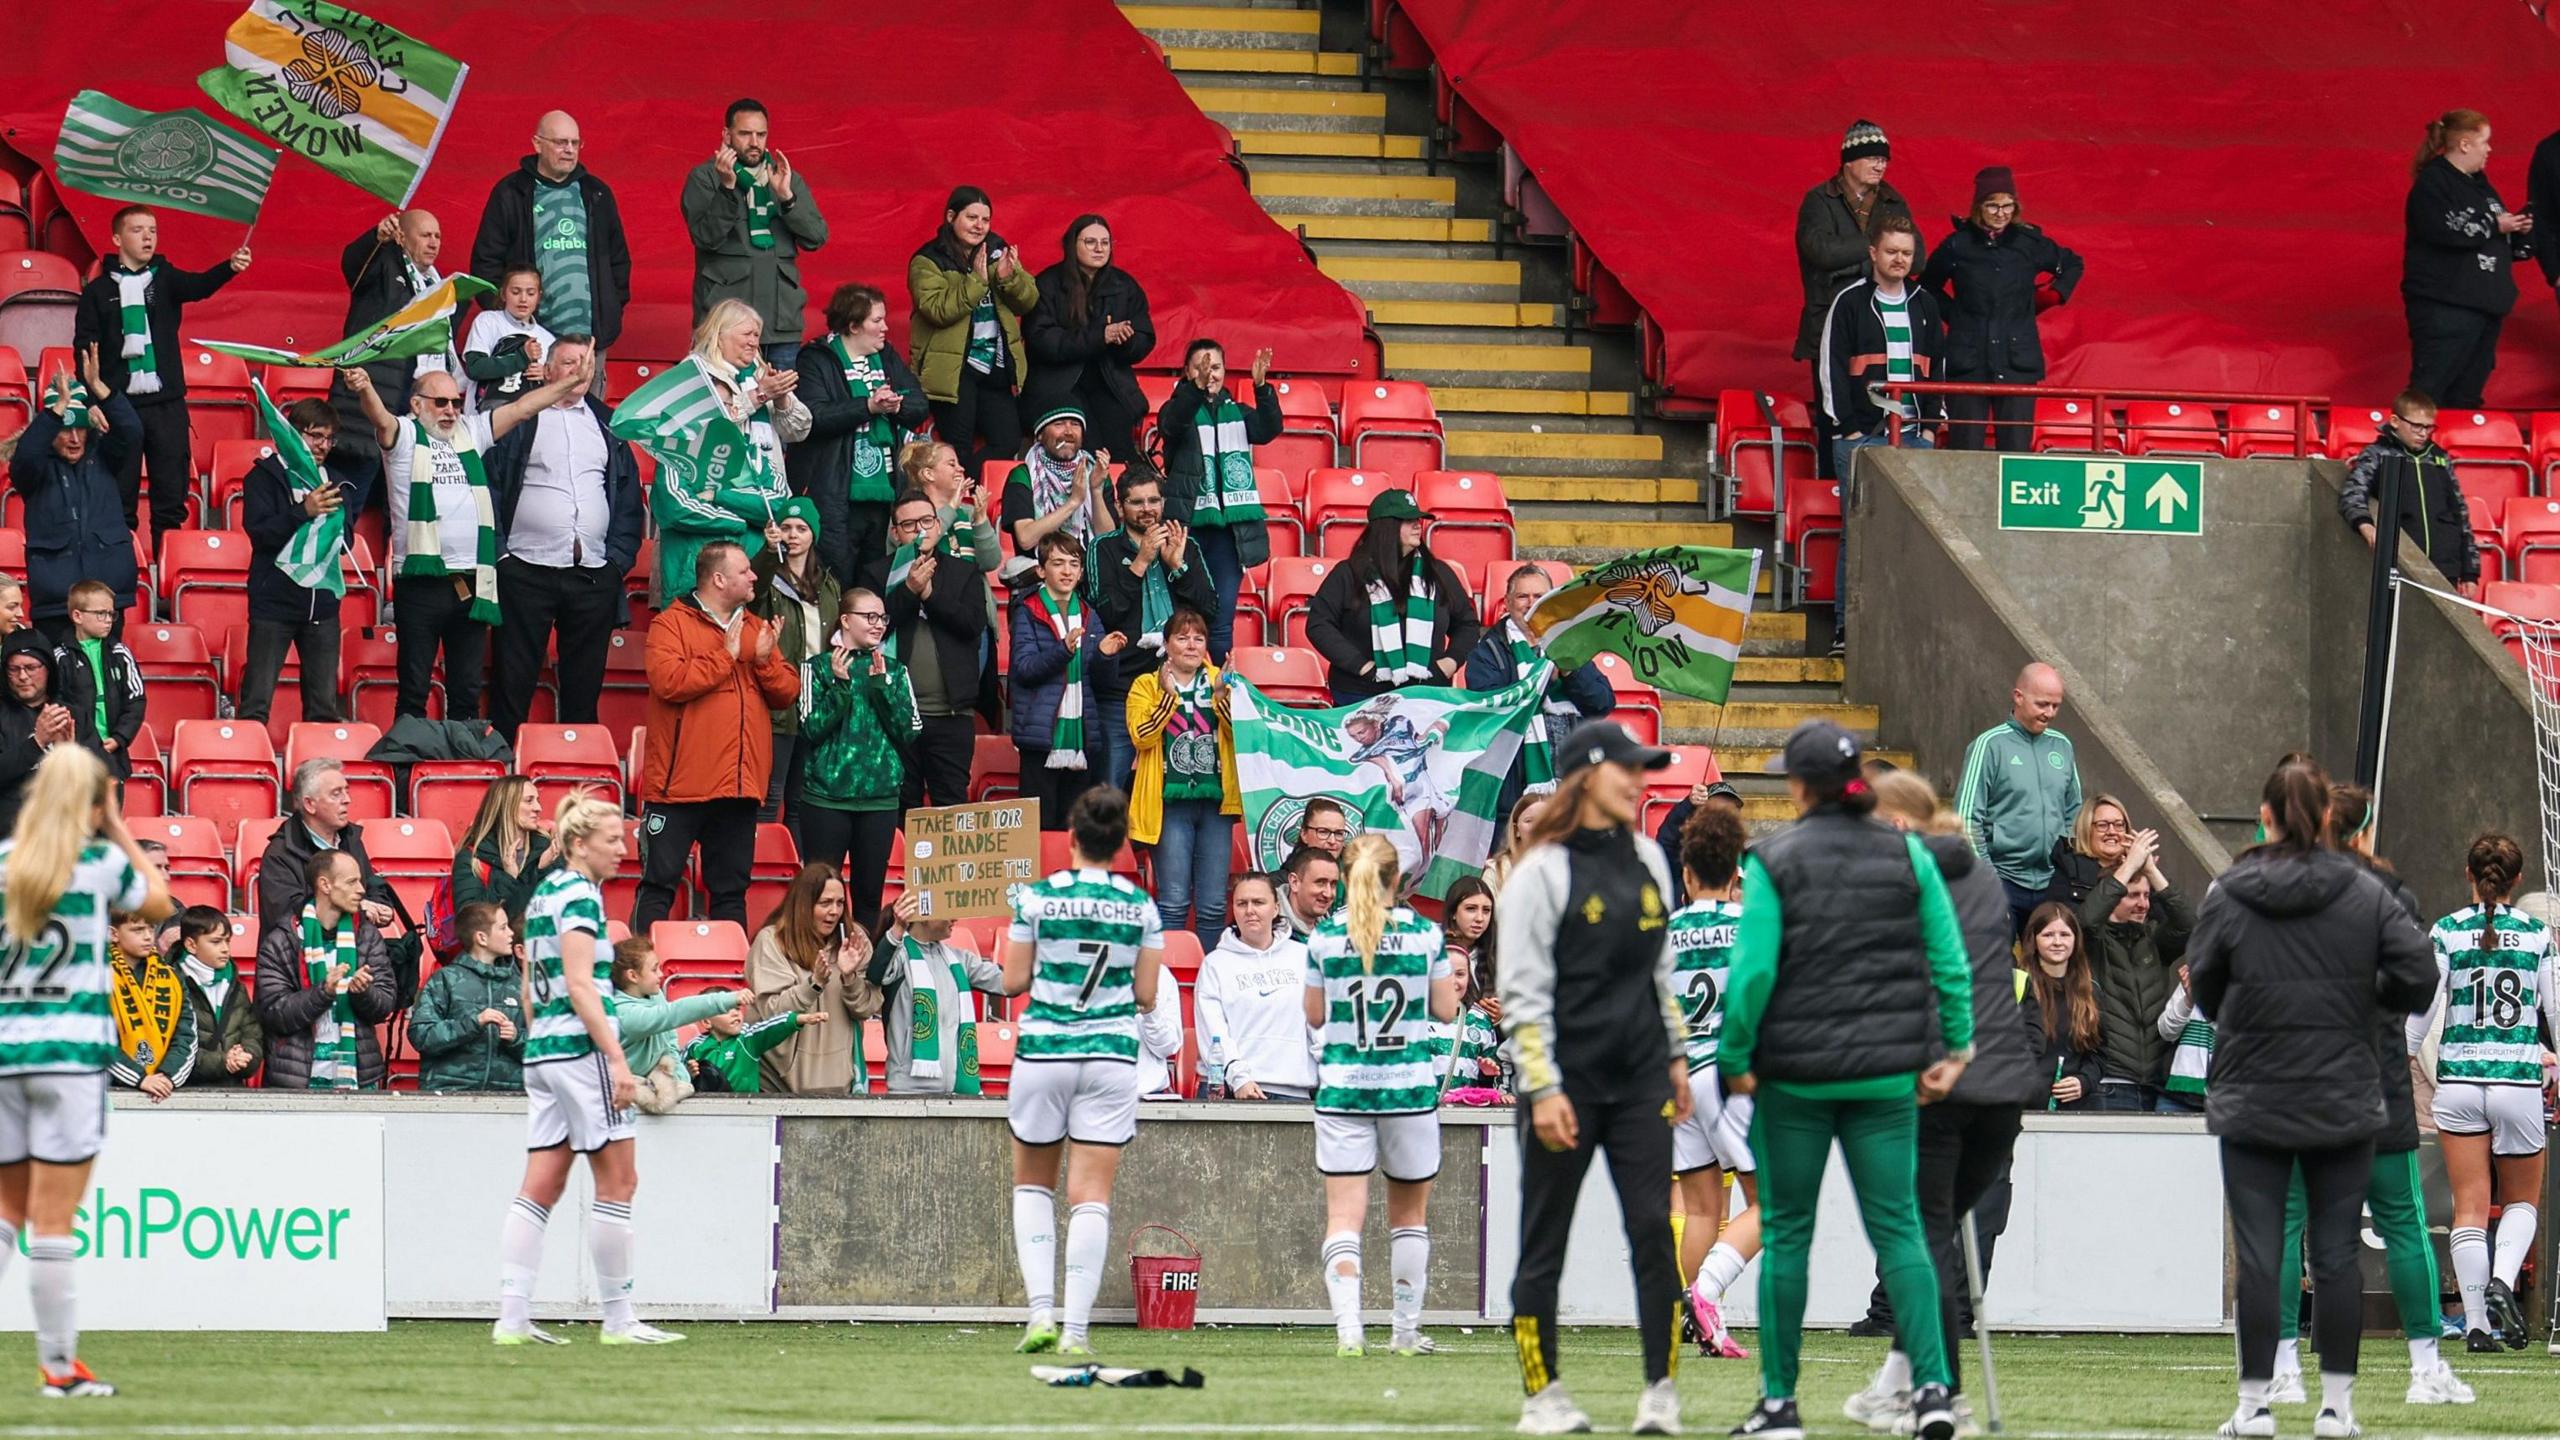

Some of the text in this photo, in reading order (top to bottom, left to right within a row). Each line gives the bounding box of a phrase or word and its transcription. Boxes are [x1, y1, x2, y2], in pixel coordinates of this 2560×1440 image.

[2011, 481, 2060, 505] Exit
[912, 810, 1021, 834] TAKE ME TO YOUR
[943, 832, 1008, 856] PARADISE
[1263, 832, 1275, 856] THE
[920, 864, 955, 885] WANT
[960, 863, 974, 880] TO
[978, 861, 1003, 879] SEE
[1005, 860, 1031, 878] THE
[944, 887, 999, 909] TROPHY
[1044, 902, 1142, 921] GALLACHER
[1344, 935, 1404, 952] AEW
[1077, 941, 1110, 1010] 7
[1686, 971, 1718, 1036] 2
[2469, 967, 2522, 1029] 18
[1348, 977, 1406, 1050] 12
[1162, 1271, 1199, 1290] FIRE
